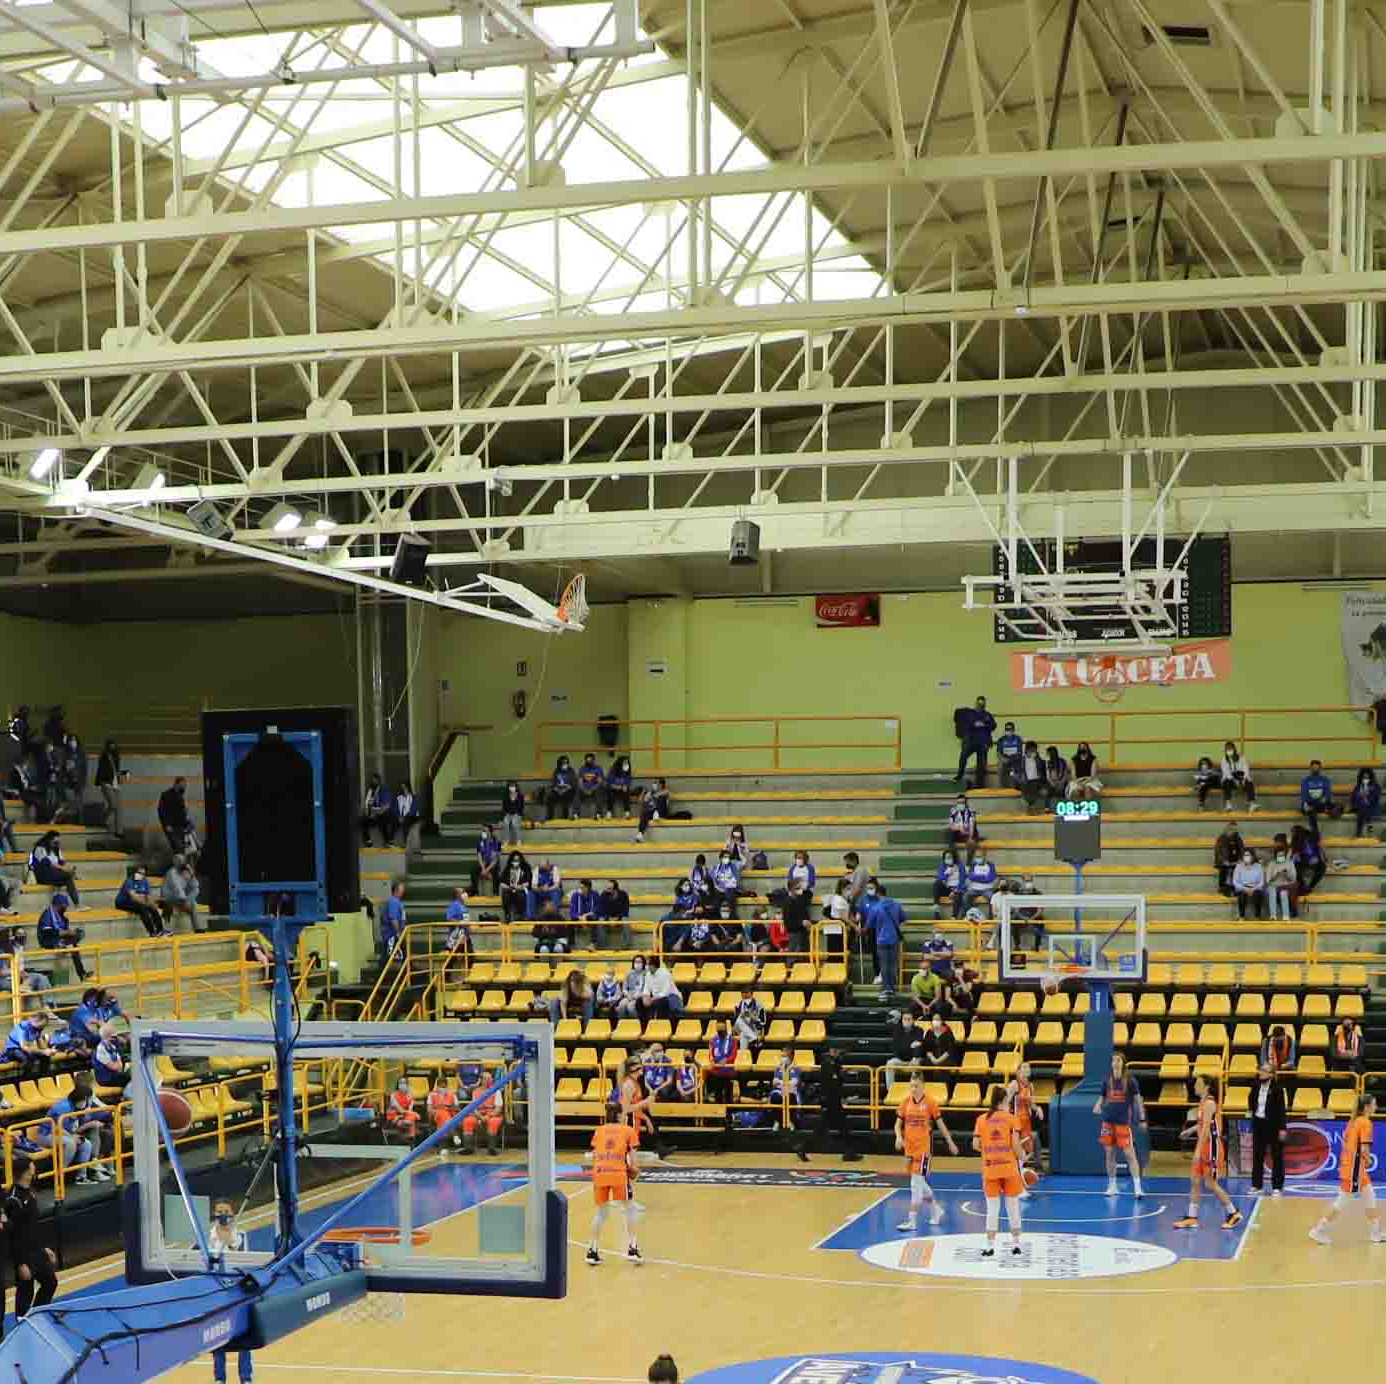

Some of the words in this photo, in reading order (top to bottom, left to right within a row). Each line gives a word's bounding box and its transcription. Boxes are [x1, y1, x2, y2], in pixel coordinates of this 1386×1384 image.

[1021, 654, 1070, 689] LA
[1076, 651, 1216, 686] GACETA
[1056, 801, 1099, 815] 08:29
